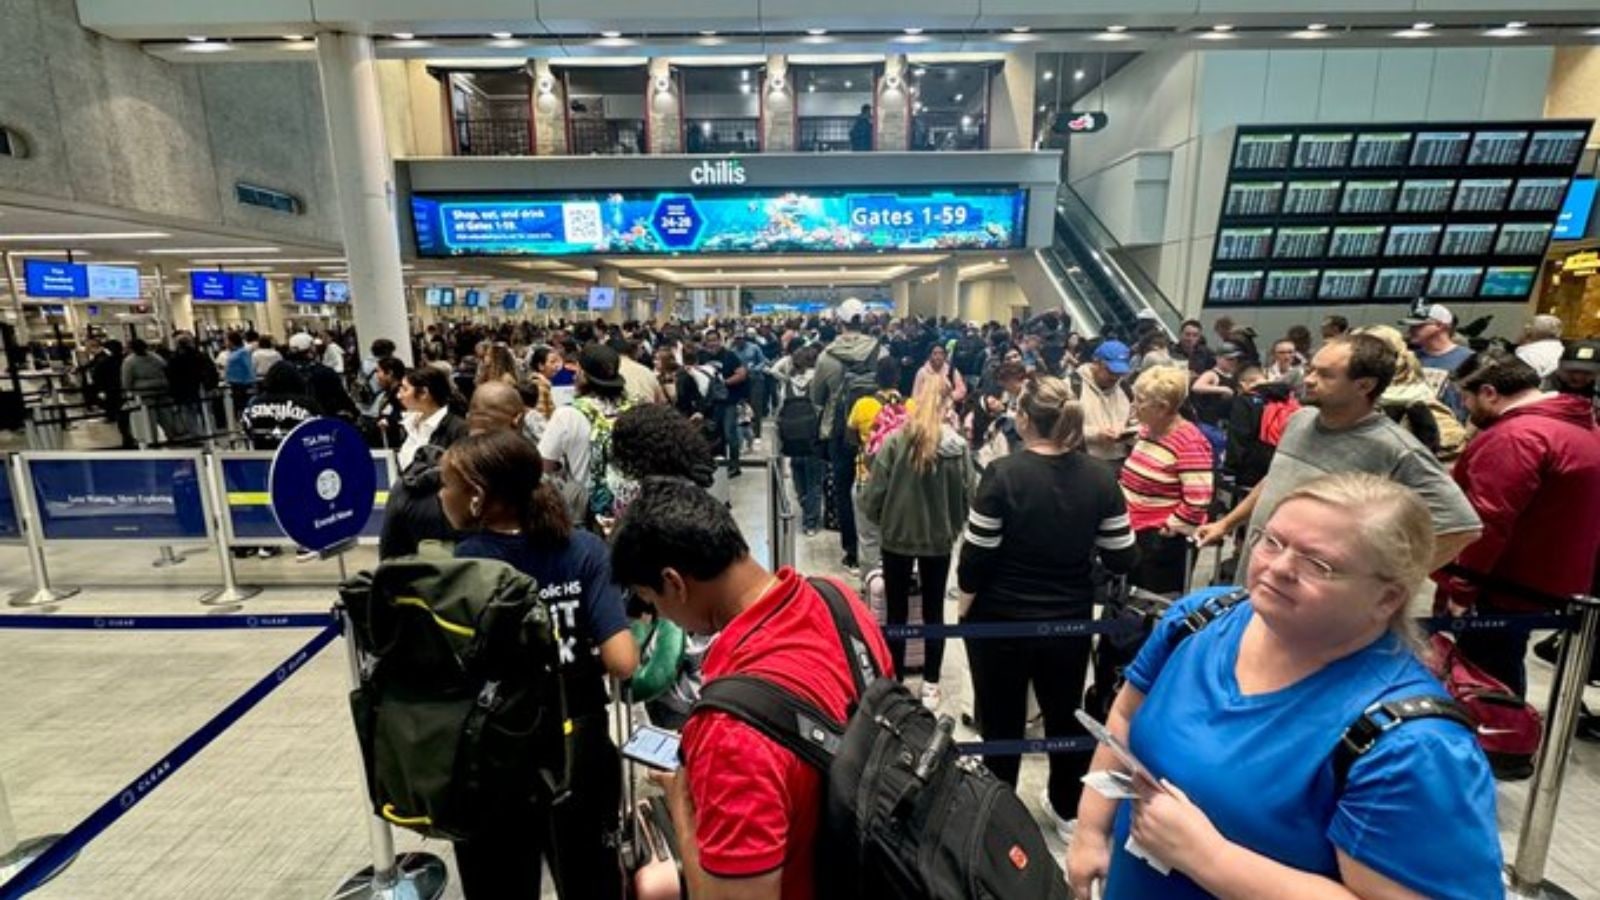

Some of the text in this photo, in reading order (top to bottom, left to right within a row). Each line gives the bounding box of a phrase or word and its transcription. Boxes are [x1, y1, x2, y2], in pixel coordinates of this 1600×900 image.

[852, 205, 967, 225] Gates 1-59
[261, 617, 289, 625] CLEAR
[1054, 624, 1086, 632] CLEAR
[137, 760, 171, 792] CLEAR
